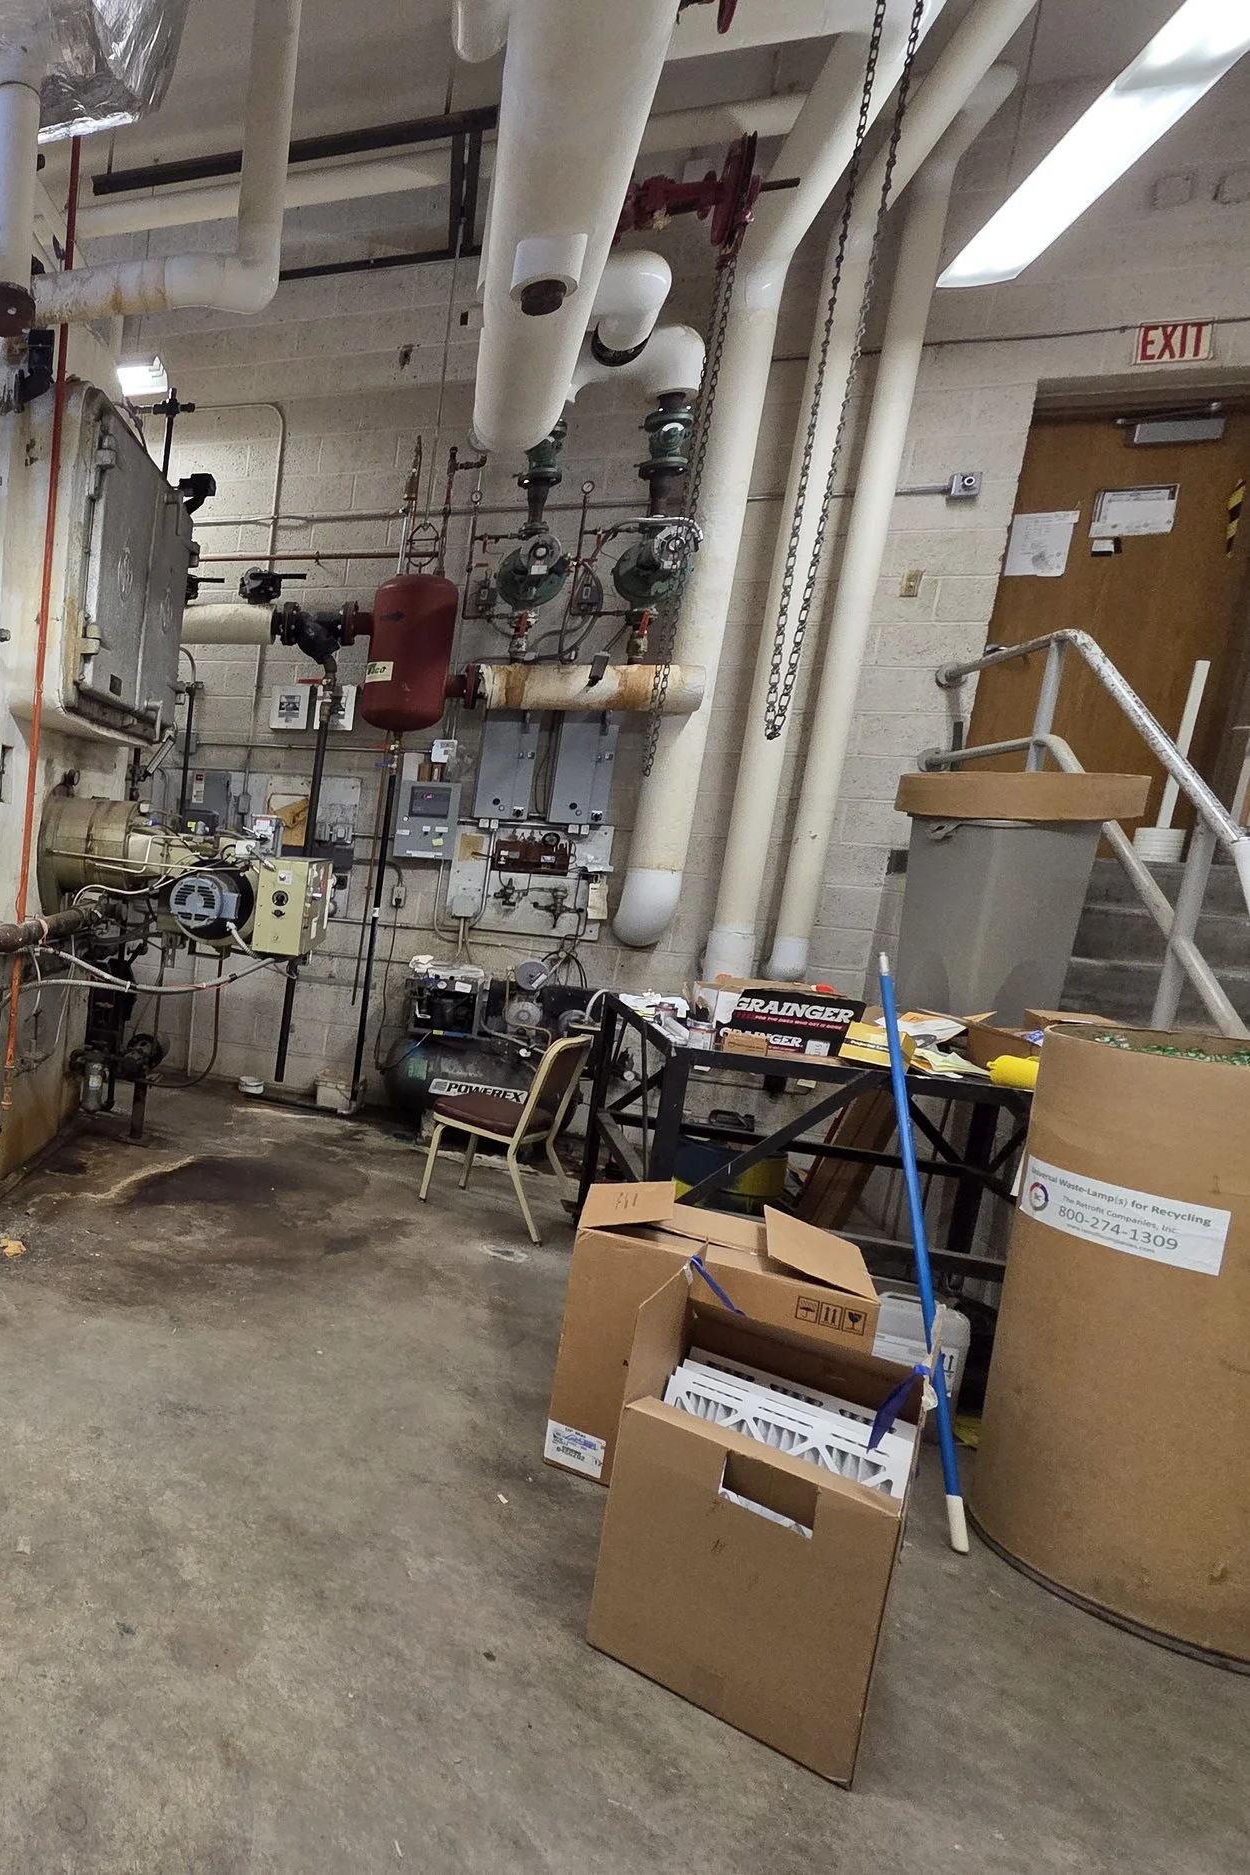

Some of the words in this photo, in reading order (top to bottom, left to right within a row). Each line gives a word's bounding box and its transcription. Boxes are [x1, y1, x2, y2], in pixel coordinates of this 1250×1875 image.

[1140, 323, 1210, 361] EXIT
[735, 997, 854, 1023] GRAINGER
[447, 1083, 523, 1102] POWEREX
[1059, 1178, 1128, 1208] Waste-Lamp(s)
[1130, 1200, 1148, 1211] for
[1151, 1206, 1212, 1227] Recycling
[1062, 1195, 1075, 1204] The
[1076, 1199, 1104, 1214] Retrofit
[1058, 1205, 1178, 1250] 800-274-1309
